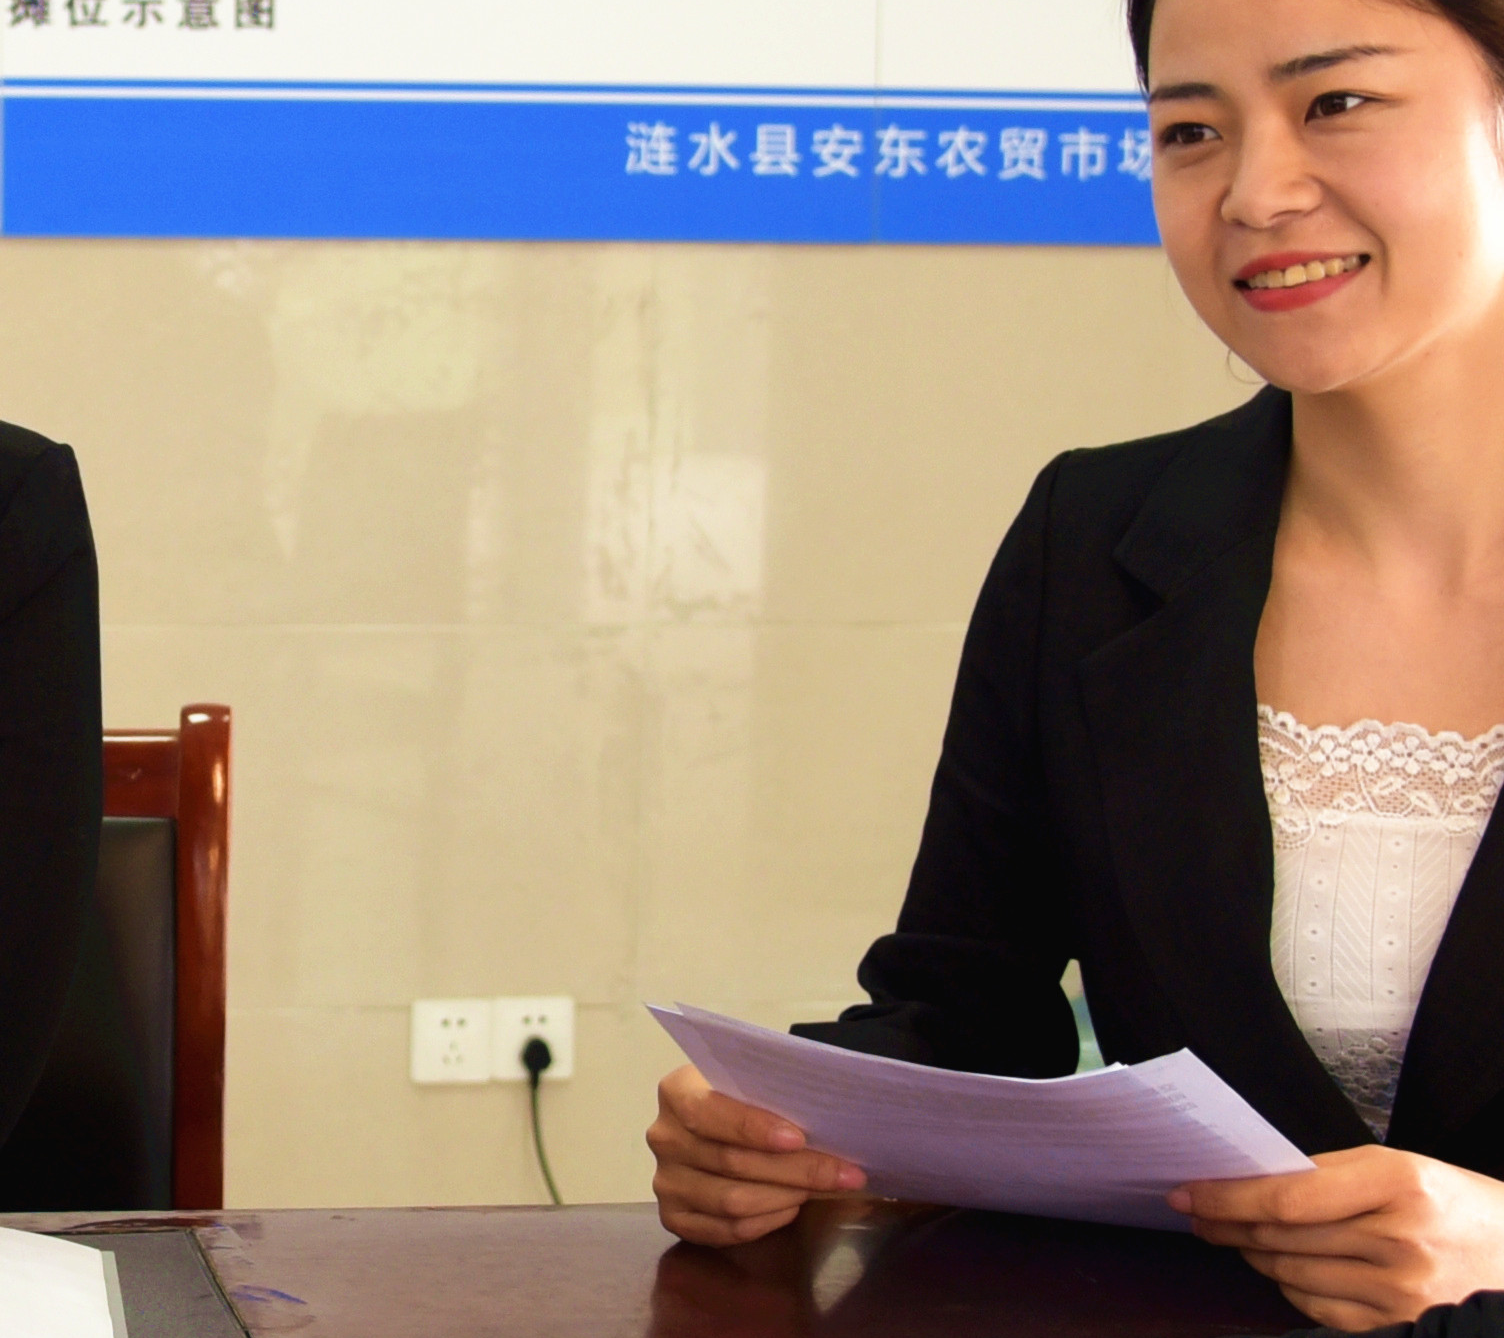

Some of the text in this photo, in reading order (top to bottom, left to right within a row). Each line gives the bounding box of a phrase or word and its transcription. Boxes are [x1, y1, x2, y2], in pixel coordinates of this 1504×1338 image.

[625, 121, 1153, 181] 涟水县安东农贸市场
